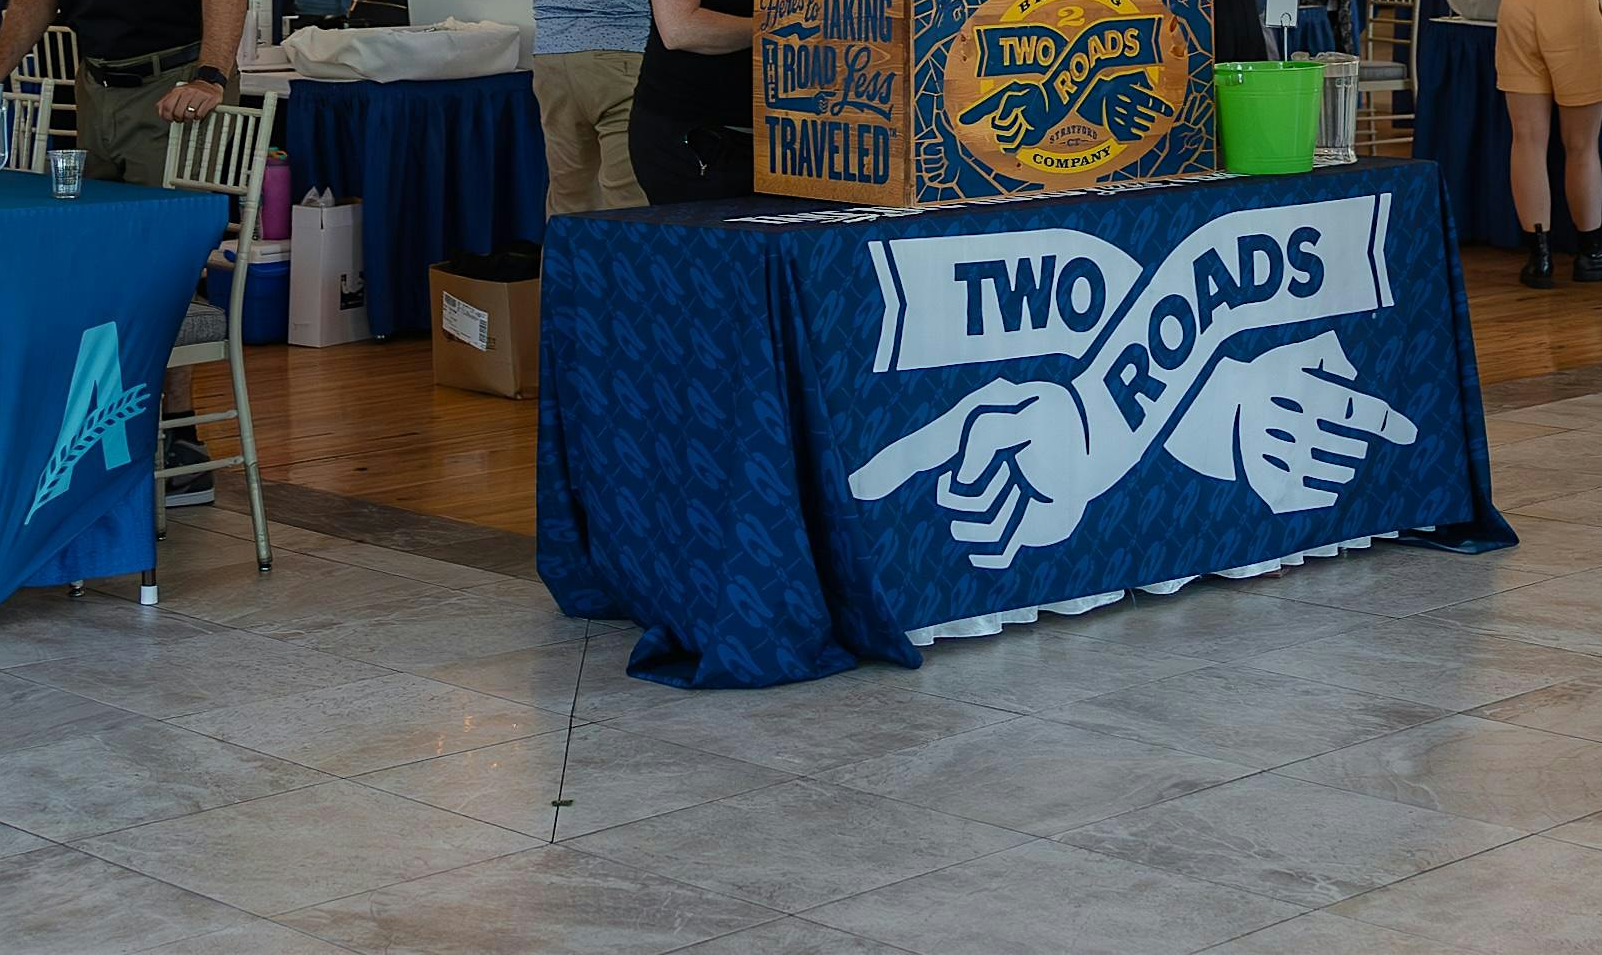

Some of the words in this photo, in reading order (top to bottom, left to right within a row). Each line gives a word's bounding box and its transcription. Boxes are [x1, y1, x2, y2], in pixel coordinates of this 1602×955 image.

[1057, 6, 1086, 27] 2
[766, 45, 776, 103] THE
[783, 44, 837, 93] ROAD
[830, 45, 897, 119] Less
[999, 36, 1056, 66] TWO
[1053, 27, 1140, 105] ROADS
[765, 115, 891, 185] TRAVELED
[1032, 145, 1112, 169] COMPANY
[1049, 124, 1098, 144] STRATFORD
[954, 255, 1106, 336] TWO
[1103, 227, 1325, 432] ROADS
